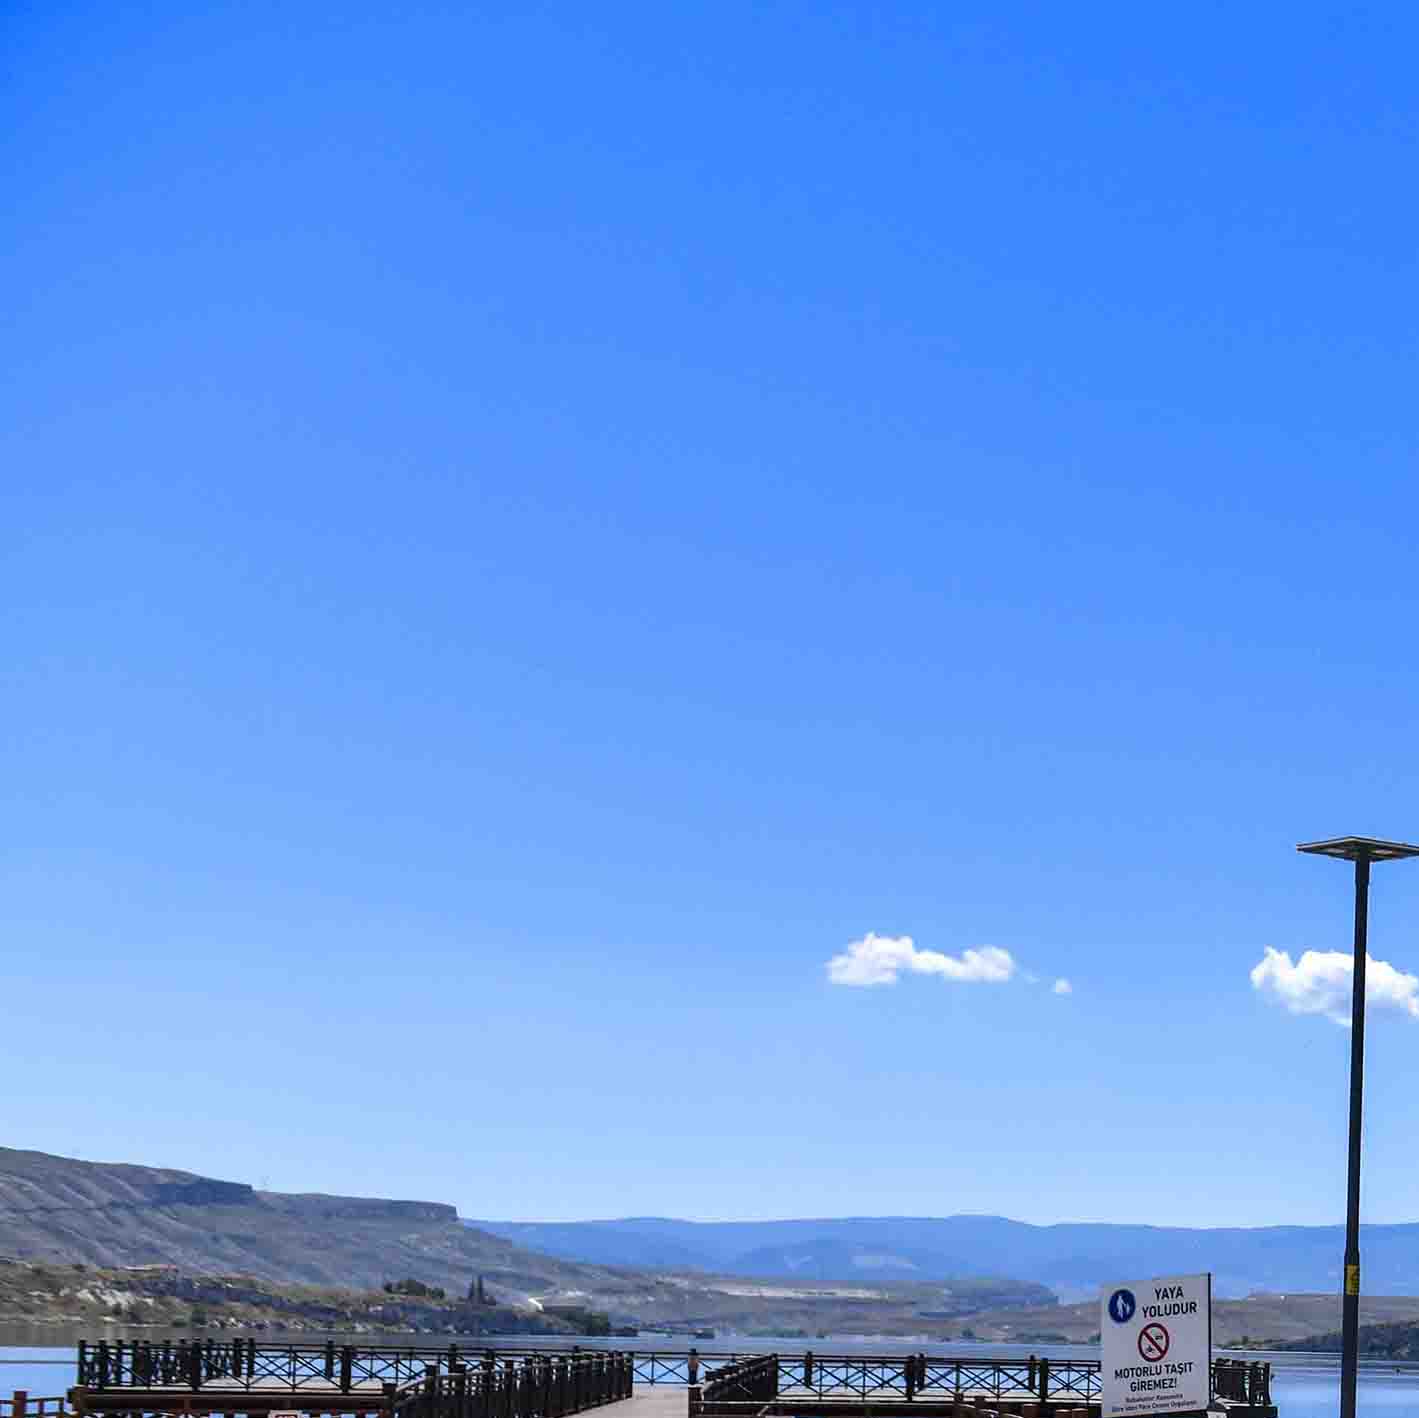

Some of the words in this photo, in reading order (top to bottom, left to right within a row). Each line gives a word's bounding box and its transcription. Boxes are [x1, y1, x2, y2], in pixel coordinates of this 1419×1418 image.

[1154, 1286, 1184, 1301] YAYA
[1142, 1302, 1197, 1318] YOLUDUR
[1114, 1364, 1162, 1379] MOTORLU
[1164, 1362, 1194, 1375] TAŞIT
[1130, 1377, 1177, 1392] GİREMEZ!
